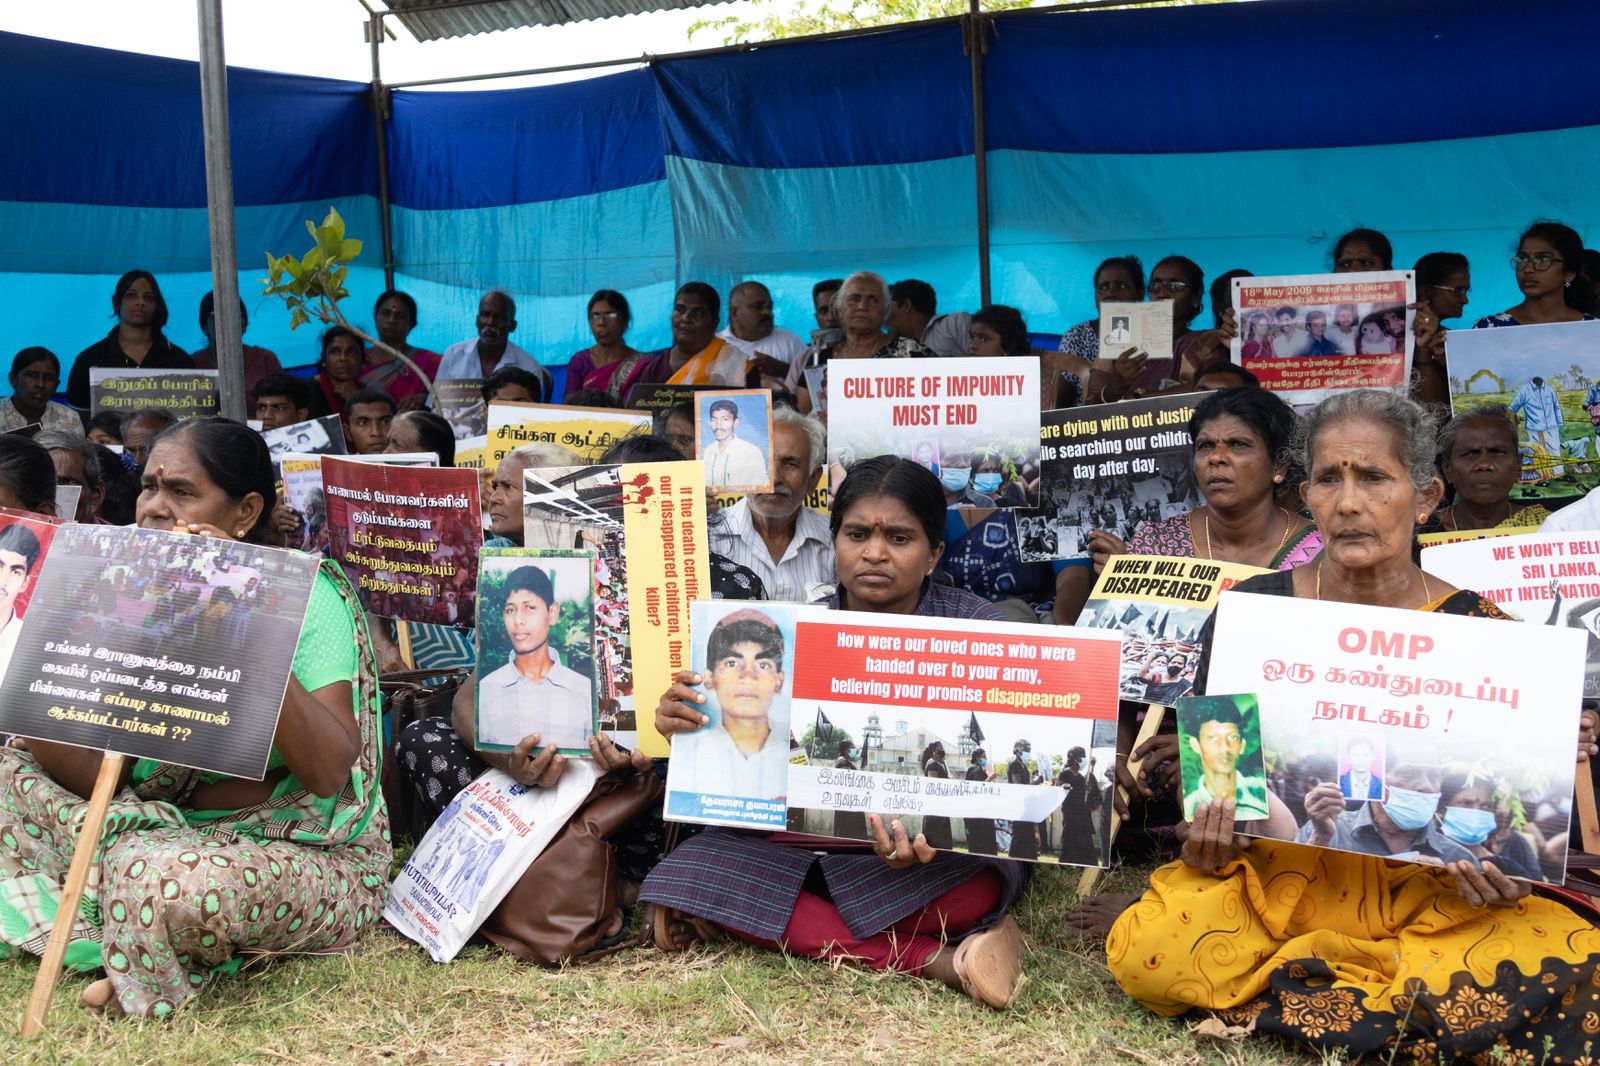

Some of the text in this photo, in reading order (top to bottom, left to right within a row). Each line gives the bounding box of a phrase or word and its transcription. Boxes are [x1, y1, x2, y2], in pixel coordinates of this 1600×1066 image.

[1263, 287, 1284, 299] May
[1287, 286, 1312, 296] 2009
[843, 374, 1025, 399] CULTURE OF IMPUNITY
[892, 403, 978, 427] MUST END
[1040, 424, 1061, 439] are
[1063, 419, 1098, 438] dying
[1100, 414, 1129, 432] with
[1132, 411, 1154, 429] out
[496, 424, 557, 443] சிங்கள
[1059, 438, 1122, 460] searching
[1125, 435, 1147, 451] our
[1073, 457, 1160, 480] day after day.
[326, 484, 469, 509] காணாமல் போனவர்களின்
[660, 475, 673, 495] our
[679, 487, 693, 496] If
[352, 510, 433, 530] குடும்பங்களை
[680, 498, 695, 518] the
[660, 500, 676, 578] disappeared
[682, 520, 698, 555] death
[1492, 540, 1600, 561] WE WON'T BELI
[1112, 560, 1221, 582] WHEN WILL OUR
[1521, 563, 1546, 580] SRI
[1101, 576, 1213, 603] DISAPPEARED
[645, 587, 661, 627] killer?
[666, 581, 682, 637] children,
[670, 640, 683, 668] then
[837, 631, 1076, 662] How were our loved ones who were
[1337, 626, 1435, 661] OMP
[44, 639, 241, 684] உங்கள் இராணுவத்தை நம்பி
[865, 656, 1042, 686] handed over to your army,
[41, 660, 230, 704] கையில் ஒப்படைத்த எங்கள்
[831, 677, 1081, 710] believing your promise disappeared?
[1262, 658, 1520, 710] ஒரு கண்துடைப்பு
[29, 679, 231, 727] பிள்ளைகள் எப்படி காணாமல்
[1311, 699, 1431, 730] நாடகம்
[46, 703, 168, 737] ஆக்கப்பட்டார்கள்
